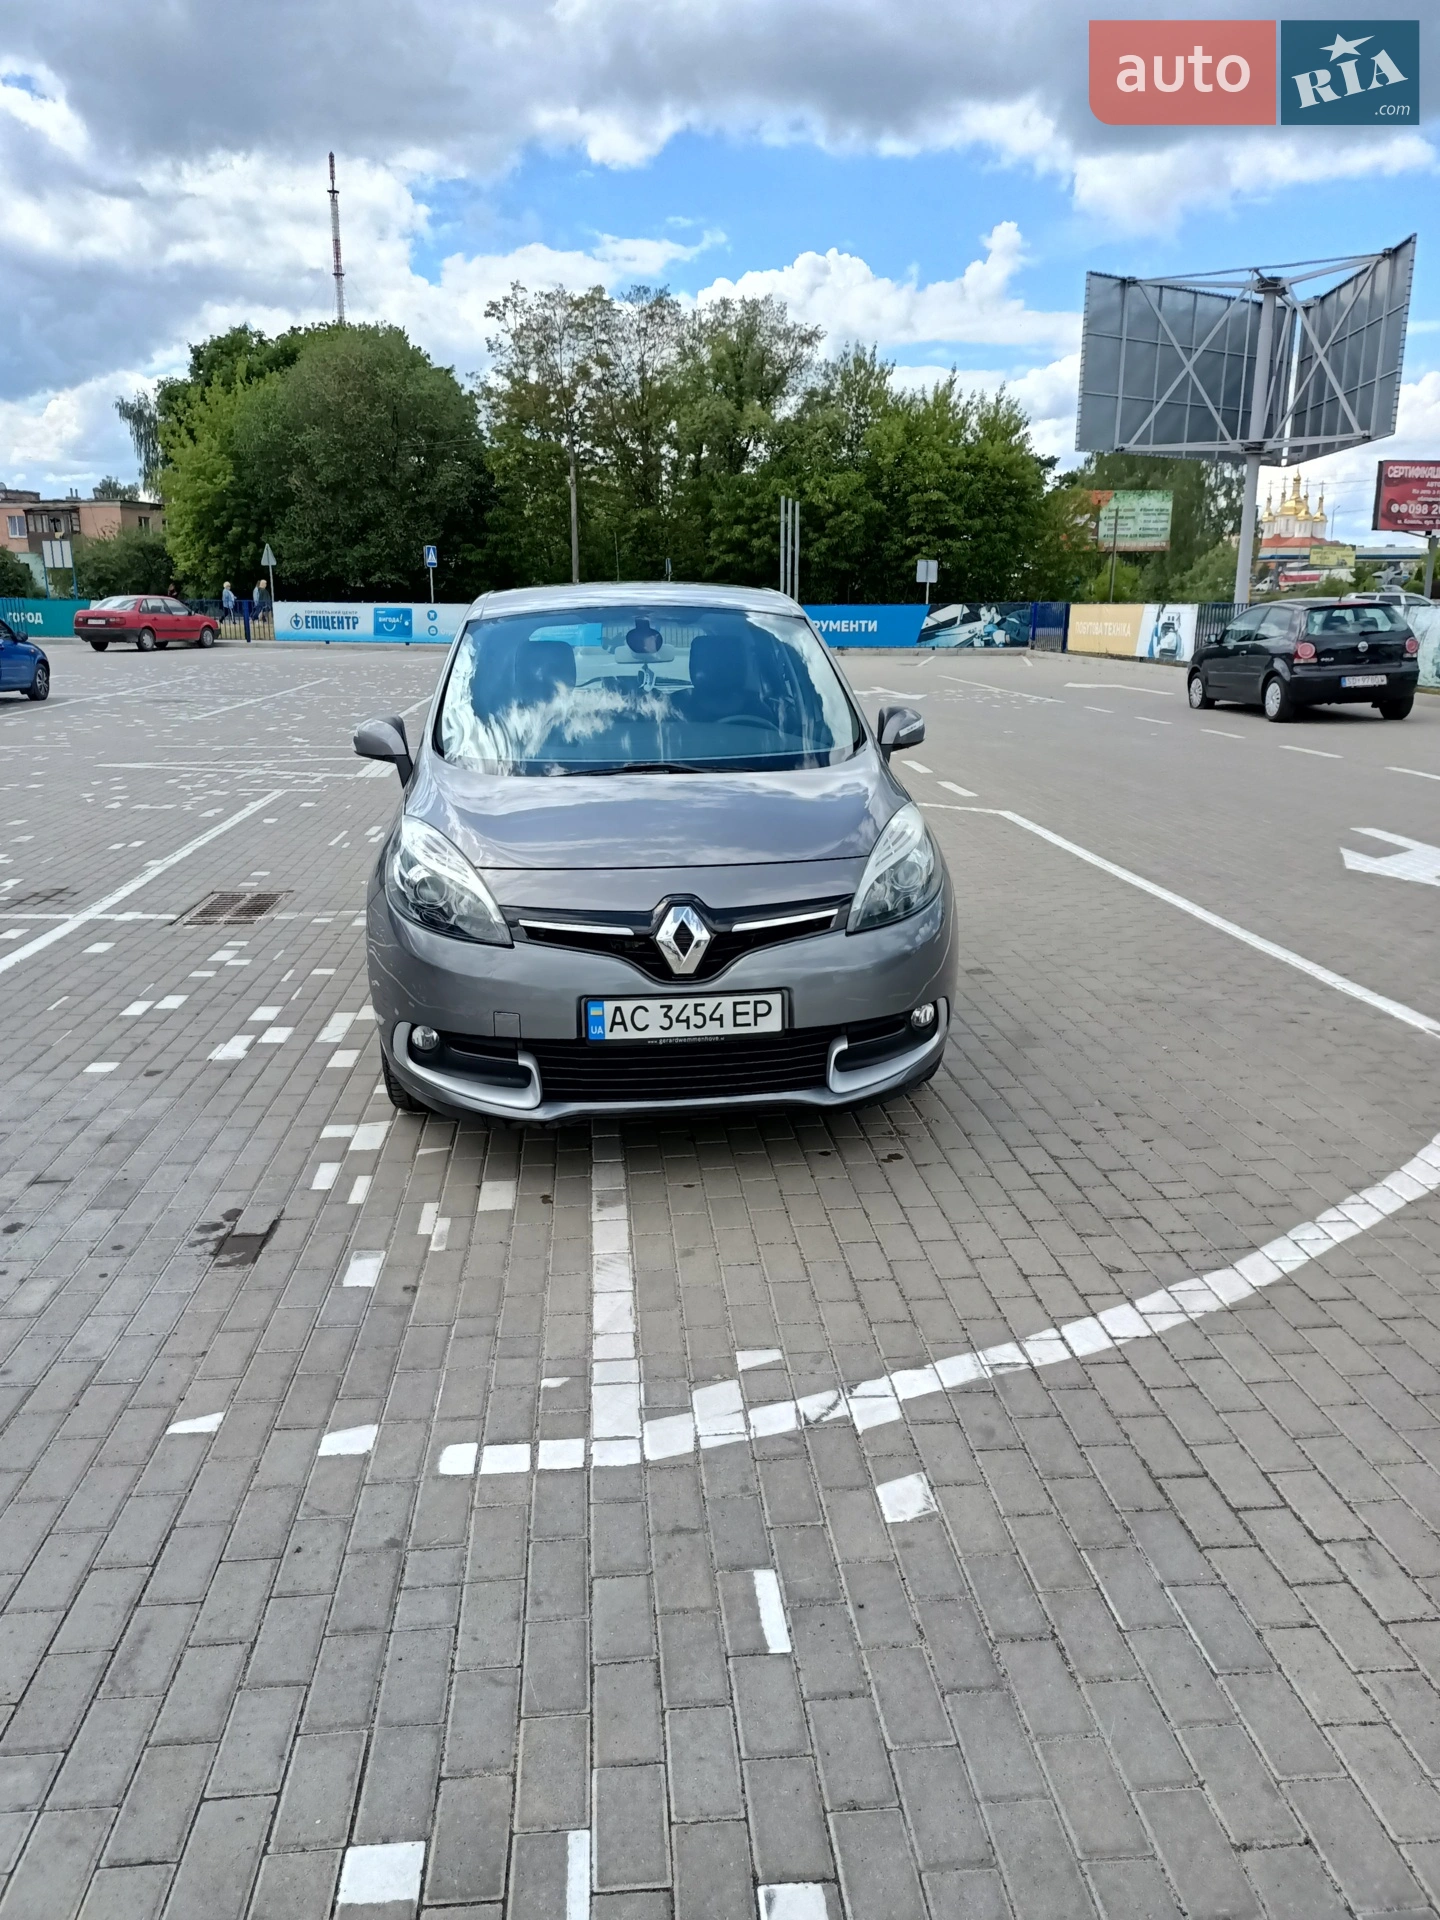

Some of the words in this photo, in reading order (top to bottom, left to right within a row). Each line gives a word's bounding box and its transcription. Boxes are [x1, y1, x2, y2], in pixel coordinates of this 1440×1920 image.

[1408, 503, 1429, 515] 098
[304, 615, 359, 631] ЕПІЦЕНТР
[1075, 621, 1103, 636] ПОБУТОВА
[1104, 622, 1131, 637] ТЕХНІКА
[608, 1005, 650, 1033] AC
[659, 1002, 724, 1031] 3454
[732, 1000, 773, 1028] EP
[590, 1025, 604, 1035] UA
